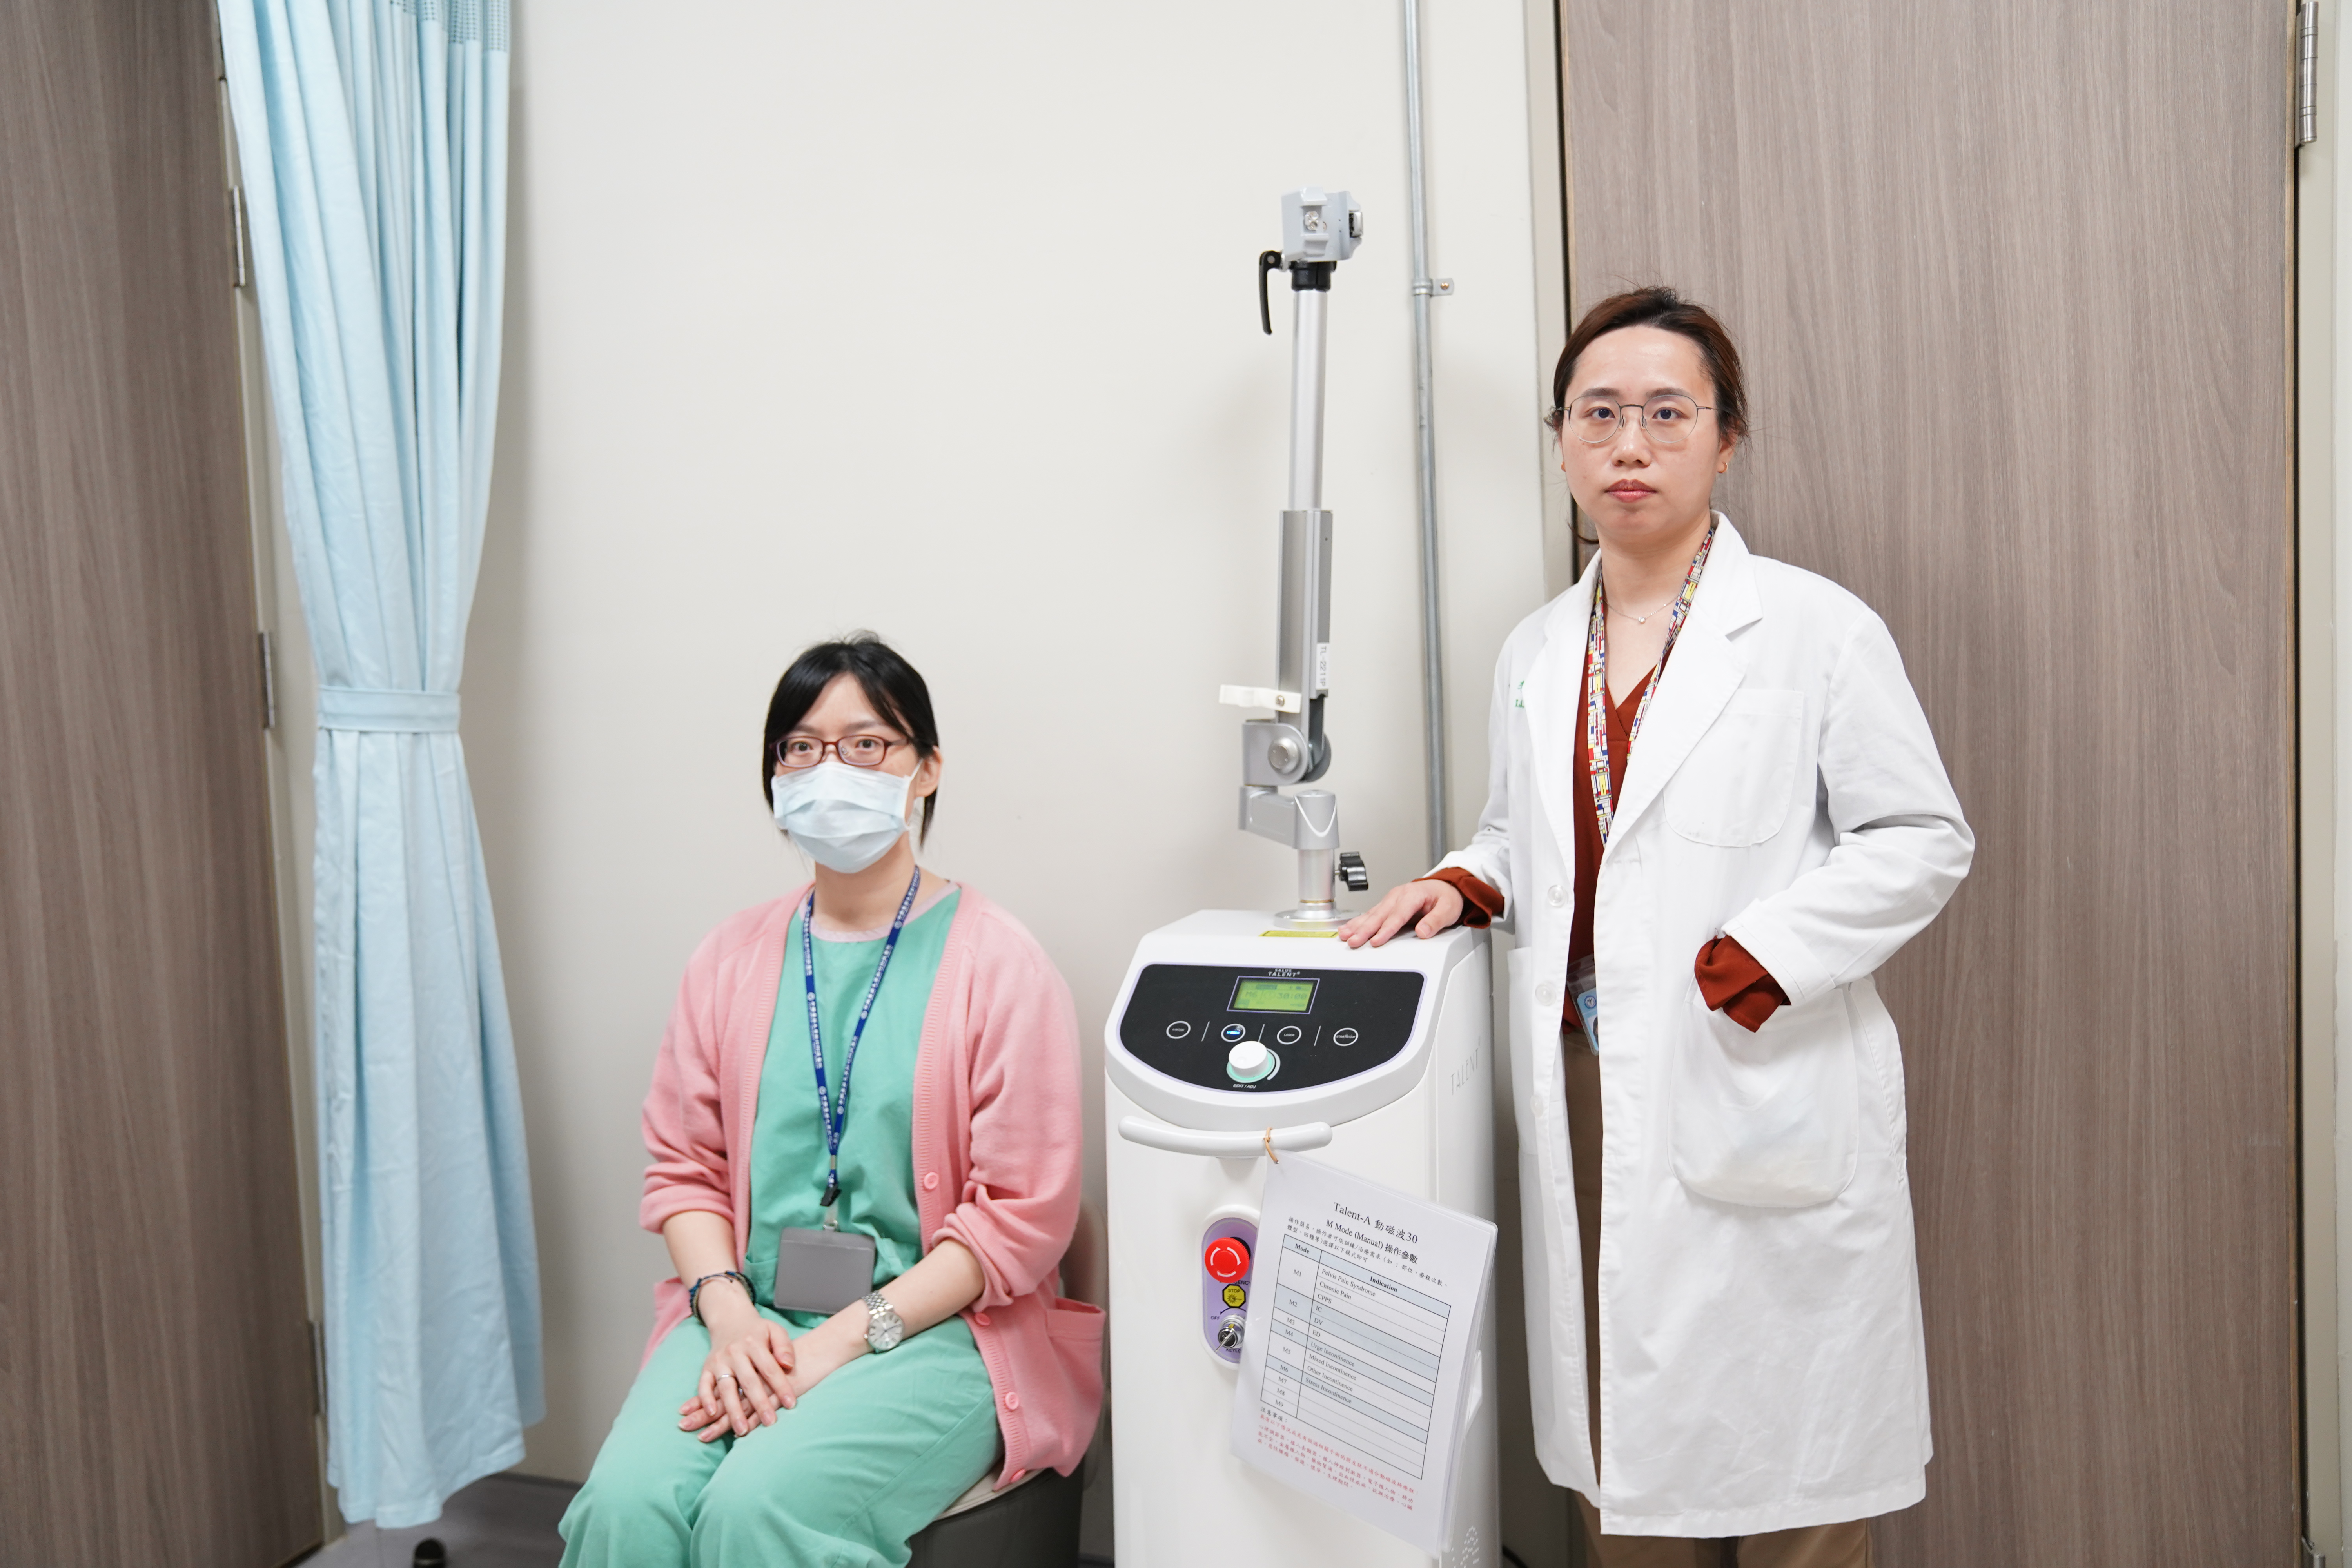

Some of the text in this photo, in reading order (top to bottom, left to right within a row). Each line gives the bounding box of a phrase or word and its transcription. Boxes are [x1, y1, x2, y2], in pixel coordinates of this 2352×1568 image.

[1334, 1202, 1418, 1244] Talent-A 動磁波30
[1326, 1219, 1418, 1265] M Mode (Manual) 操作參數
[1295, 1243, 1397, 1292] Mode Indication
[1319, 1281, 1351, 1300] Chronic Pain
[1321, 1269, 1376, 1297] Pelvis Pain Syndrome
[1289, 1299, 1298, 1307] M2
[1318, 1294, 1332, 1304] CPPS
[1311, 1341, 1355, 1367] Urge Incontinence
[1307, 1366, 1353, 1392] Other Incontinence
[1309, 1354, 1356, 1381] Mixed Incontinence
[1277, 1388, 1285, 1396] M8
[1305, 1377, 1352, 1404] Stress Incontinence
